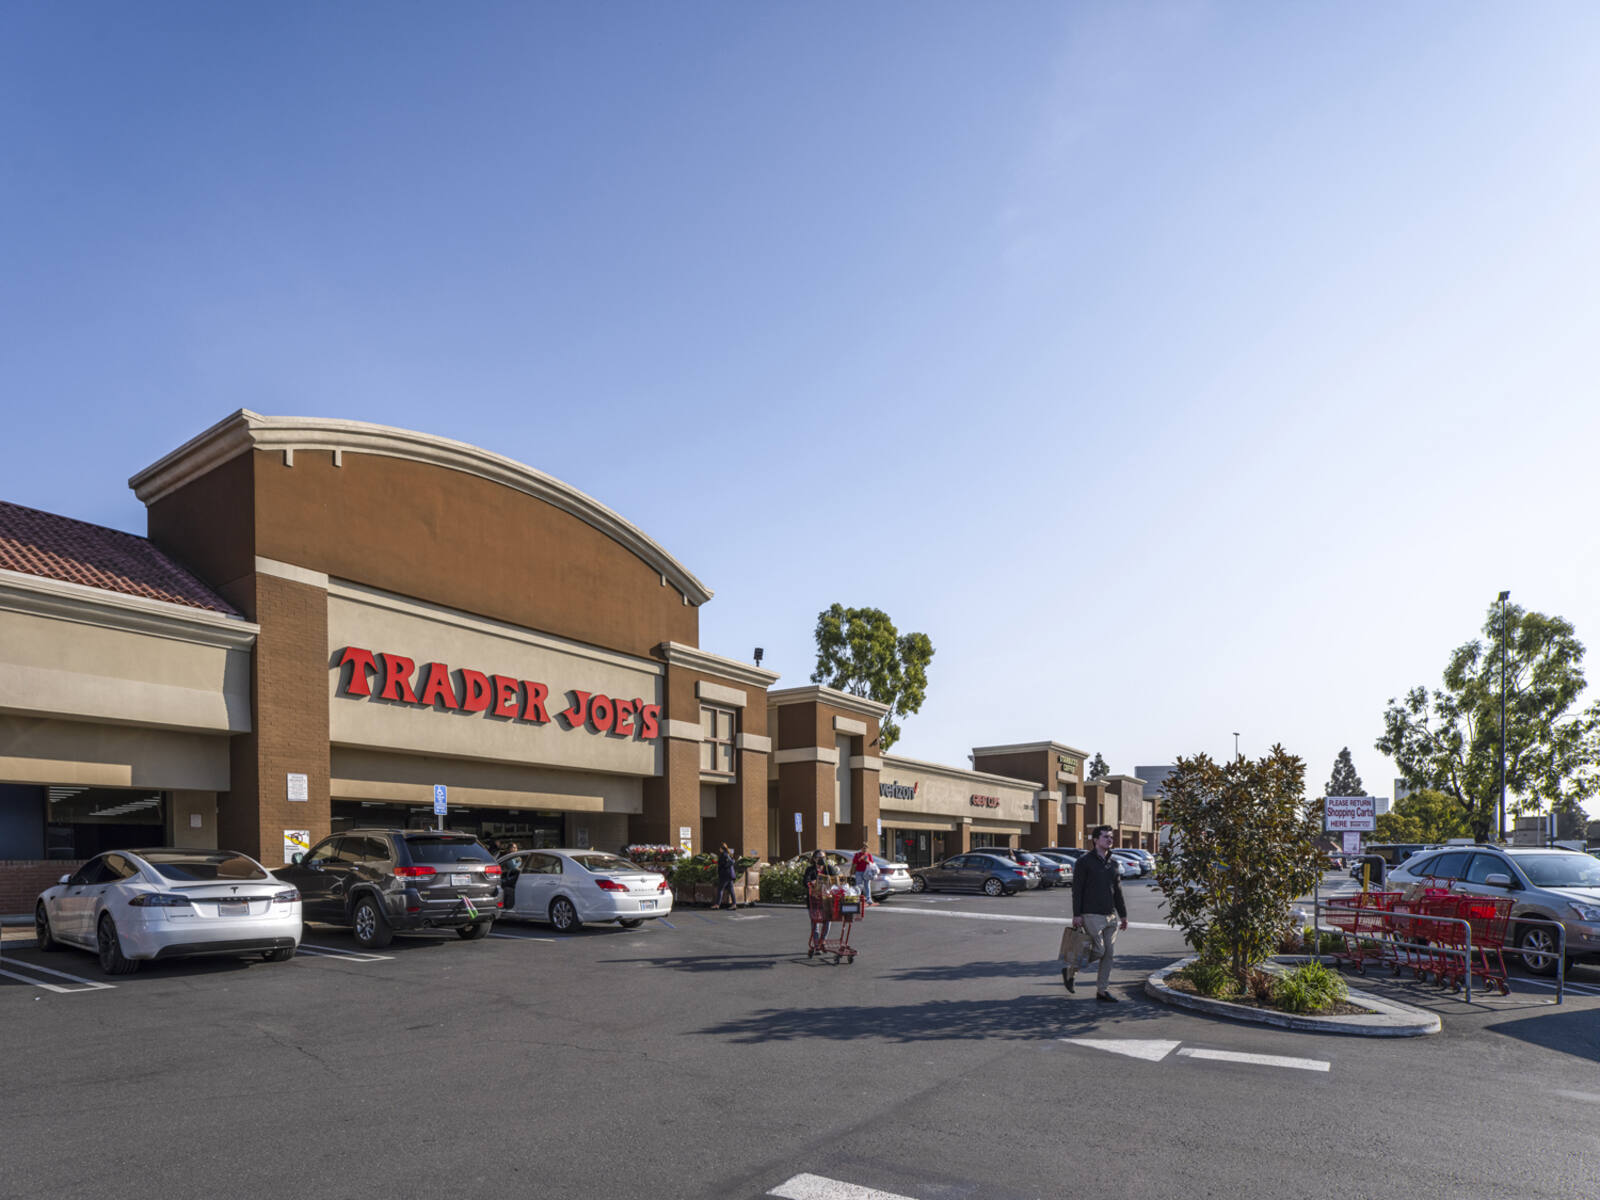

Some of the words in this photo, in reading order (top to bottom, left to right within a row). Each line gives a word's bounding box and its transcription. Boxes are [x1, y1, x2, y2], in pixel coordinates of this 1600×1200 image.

[338, 646, 551, 723] TRADER
[560, 689, 662, 739] JOE'S
[879, 780, 914, 800] verizon
[1328, 807, 1355, 819] Shopping
[1356, 807, 1374, 816] Carts
